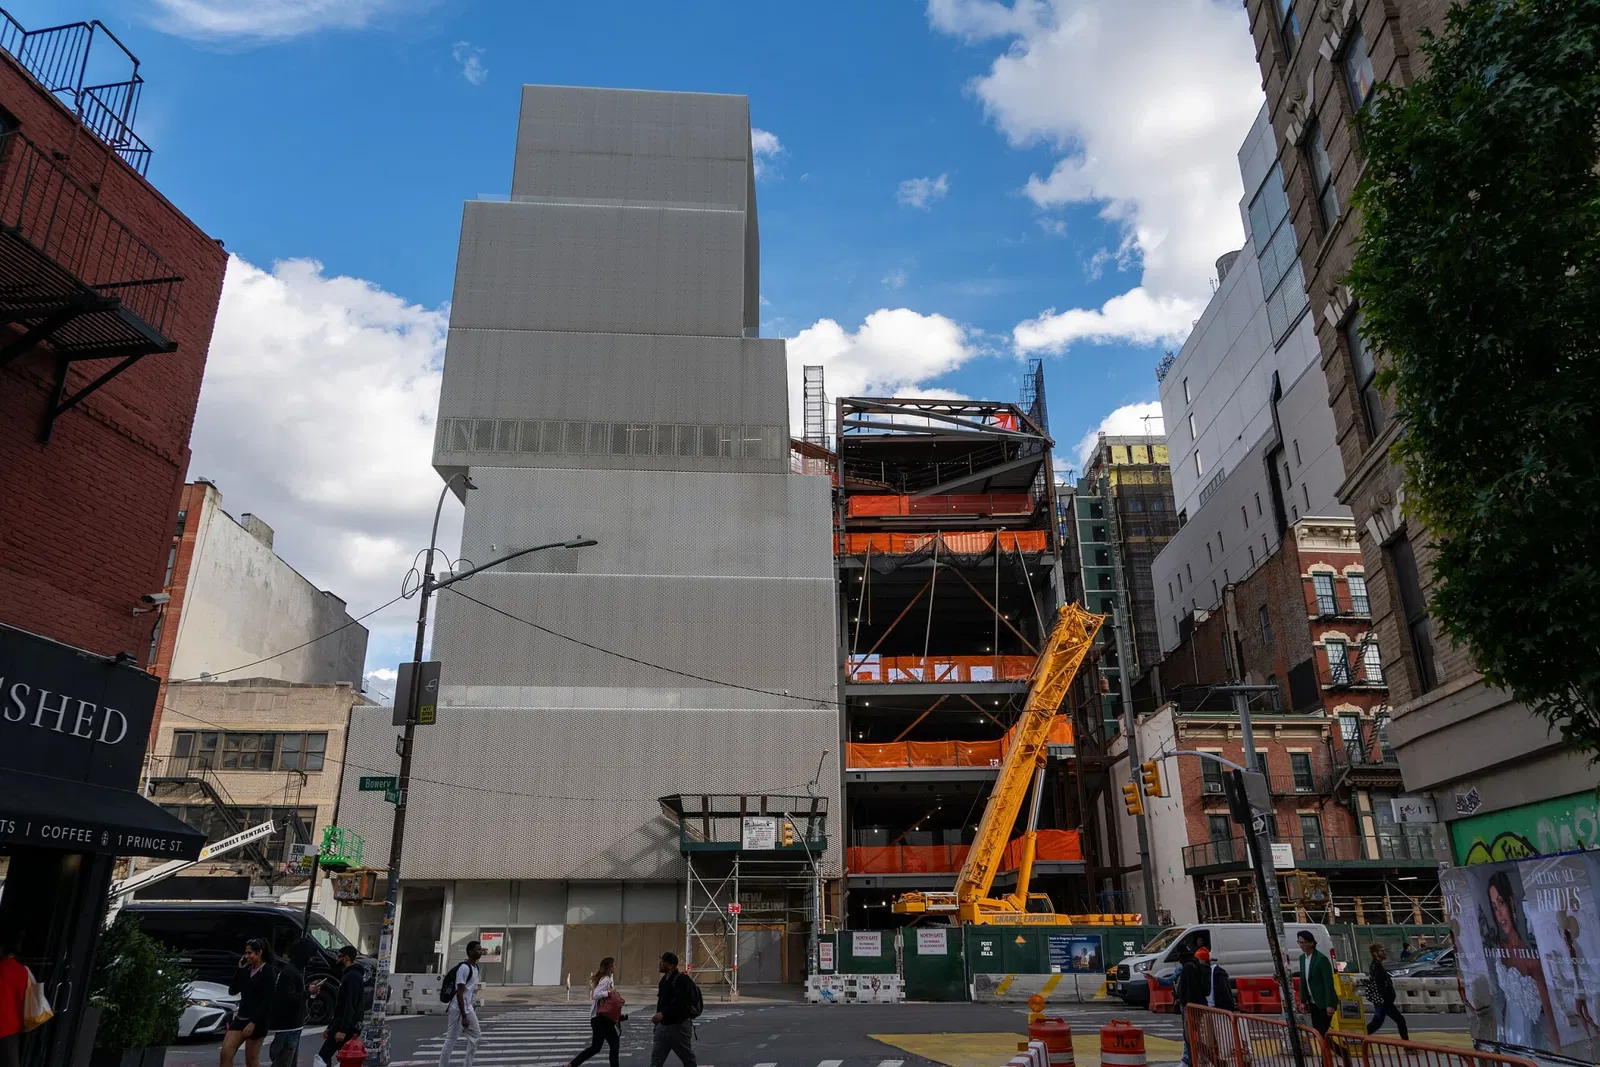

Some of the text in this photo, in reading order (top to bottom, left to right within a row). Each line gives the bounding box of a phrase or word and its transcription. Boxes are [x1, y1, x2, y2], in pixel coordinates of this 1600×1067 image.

[0, 677, 128, 744] SHED
[365, 778, 392, 788] Bowery
[1399, 805, 1431, 815] EIT
[41, 824, 93, 842] COFFEE
[117, 834, 123, 846] 1
[126, 835, 167, 850] PRINCE
[169, 840, 184, 852] ST.
[209, 824, 270, 853] SUNBELT RENTALS
[738, 892, 762, 902] NEW
[1535, 886, 1581, 912] BRIDES
[994, 914, 1054, 923] CRANES EXPRESS
